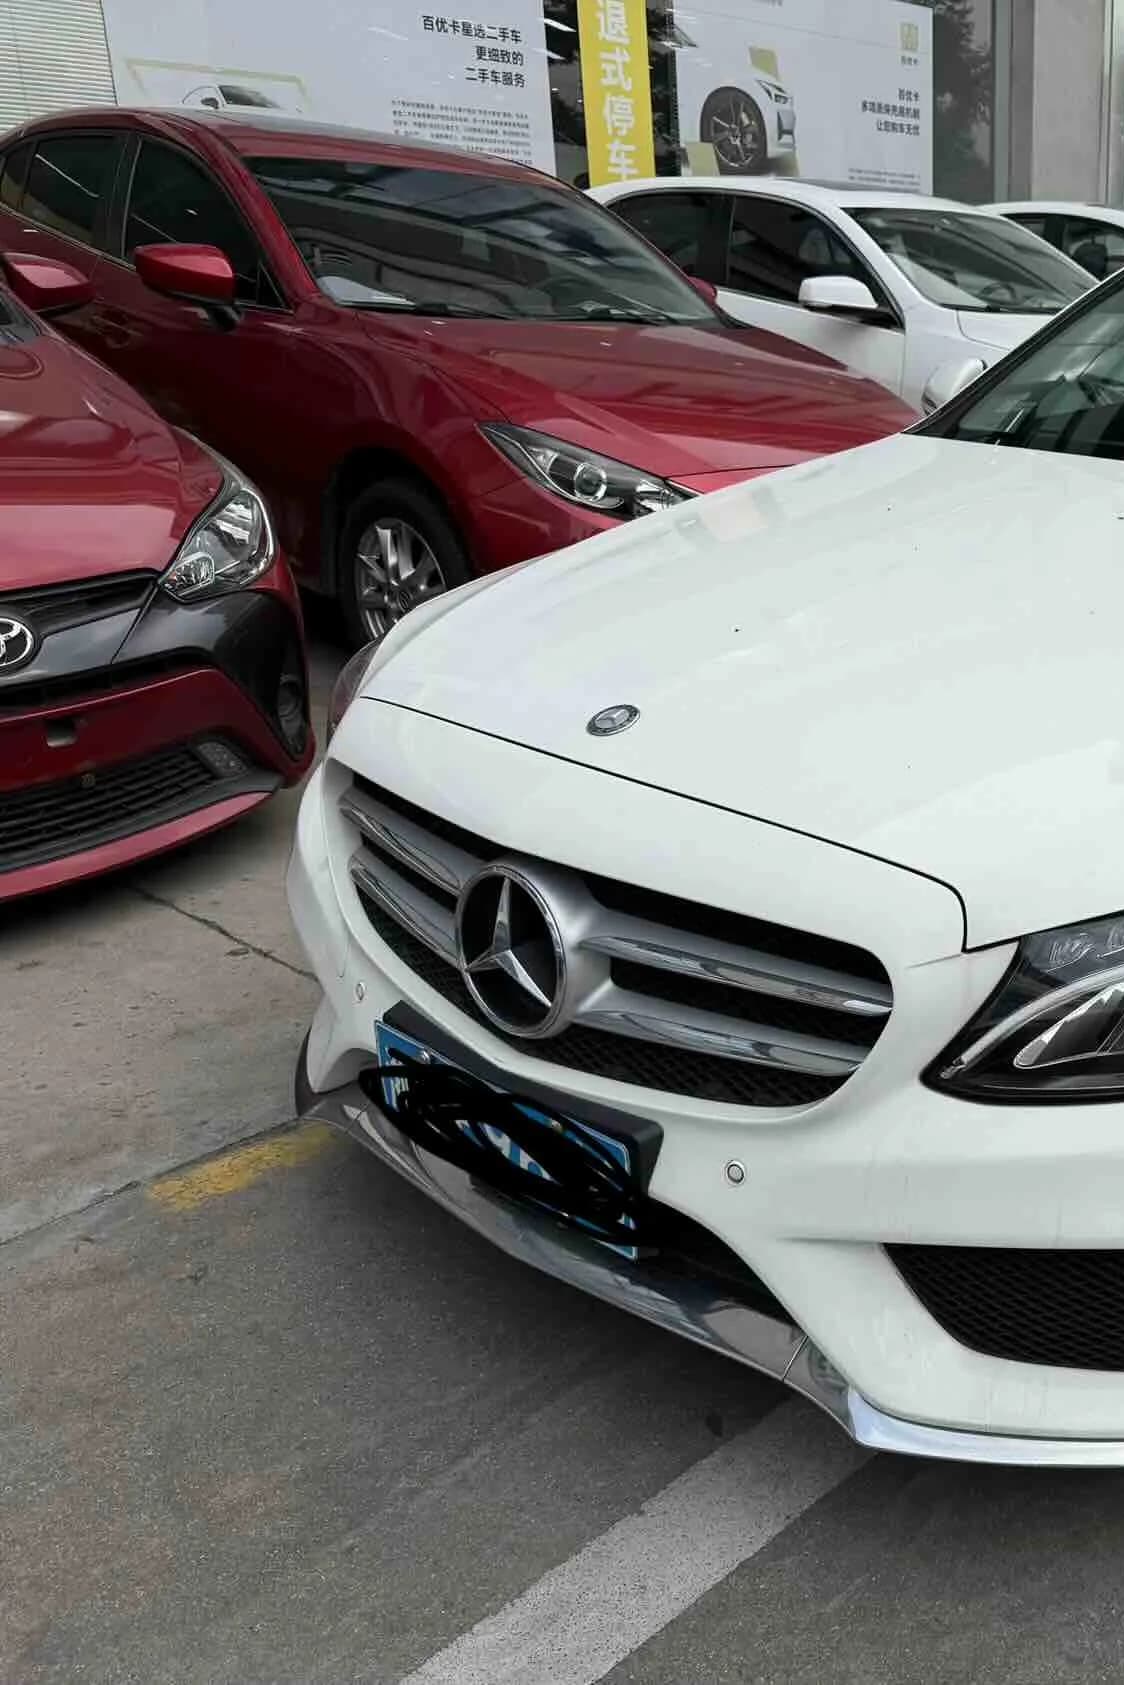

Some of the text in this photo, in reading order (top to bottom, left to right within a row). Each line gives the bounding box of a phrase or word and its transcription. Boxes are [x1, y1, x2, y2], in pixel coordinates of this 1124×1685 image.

[421, 15, 523, 44] 百优卡星选二手车
[475, 46, 525, 66] 更细致的
[465, 67, 526, 88] 二手车服务
